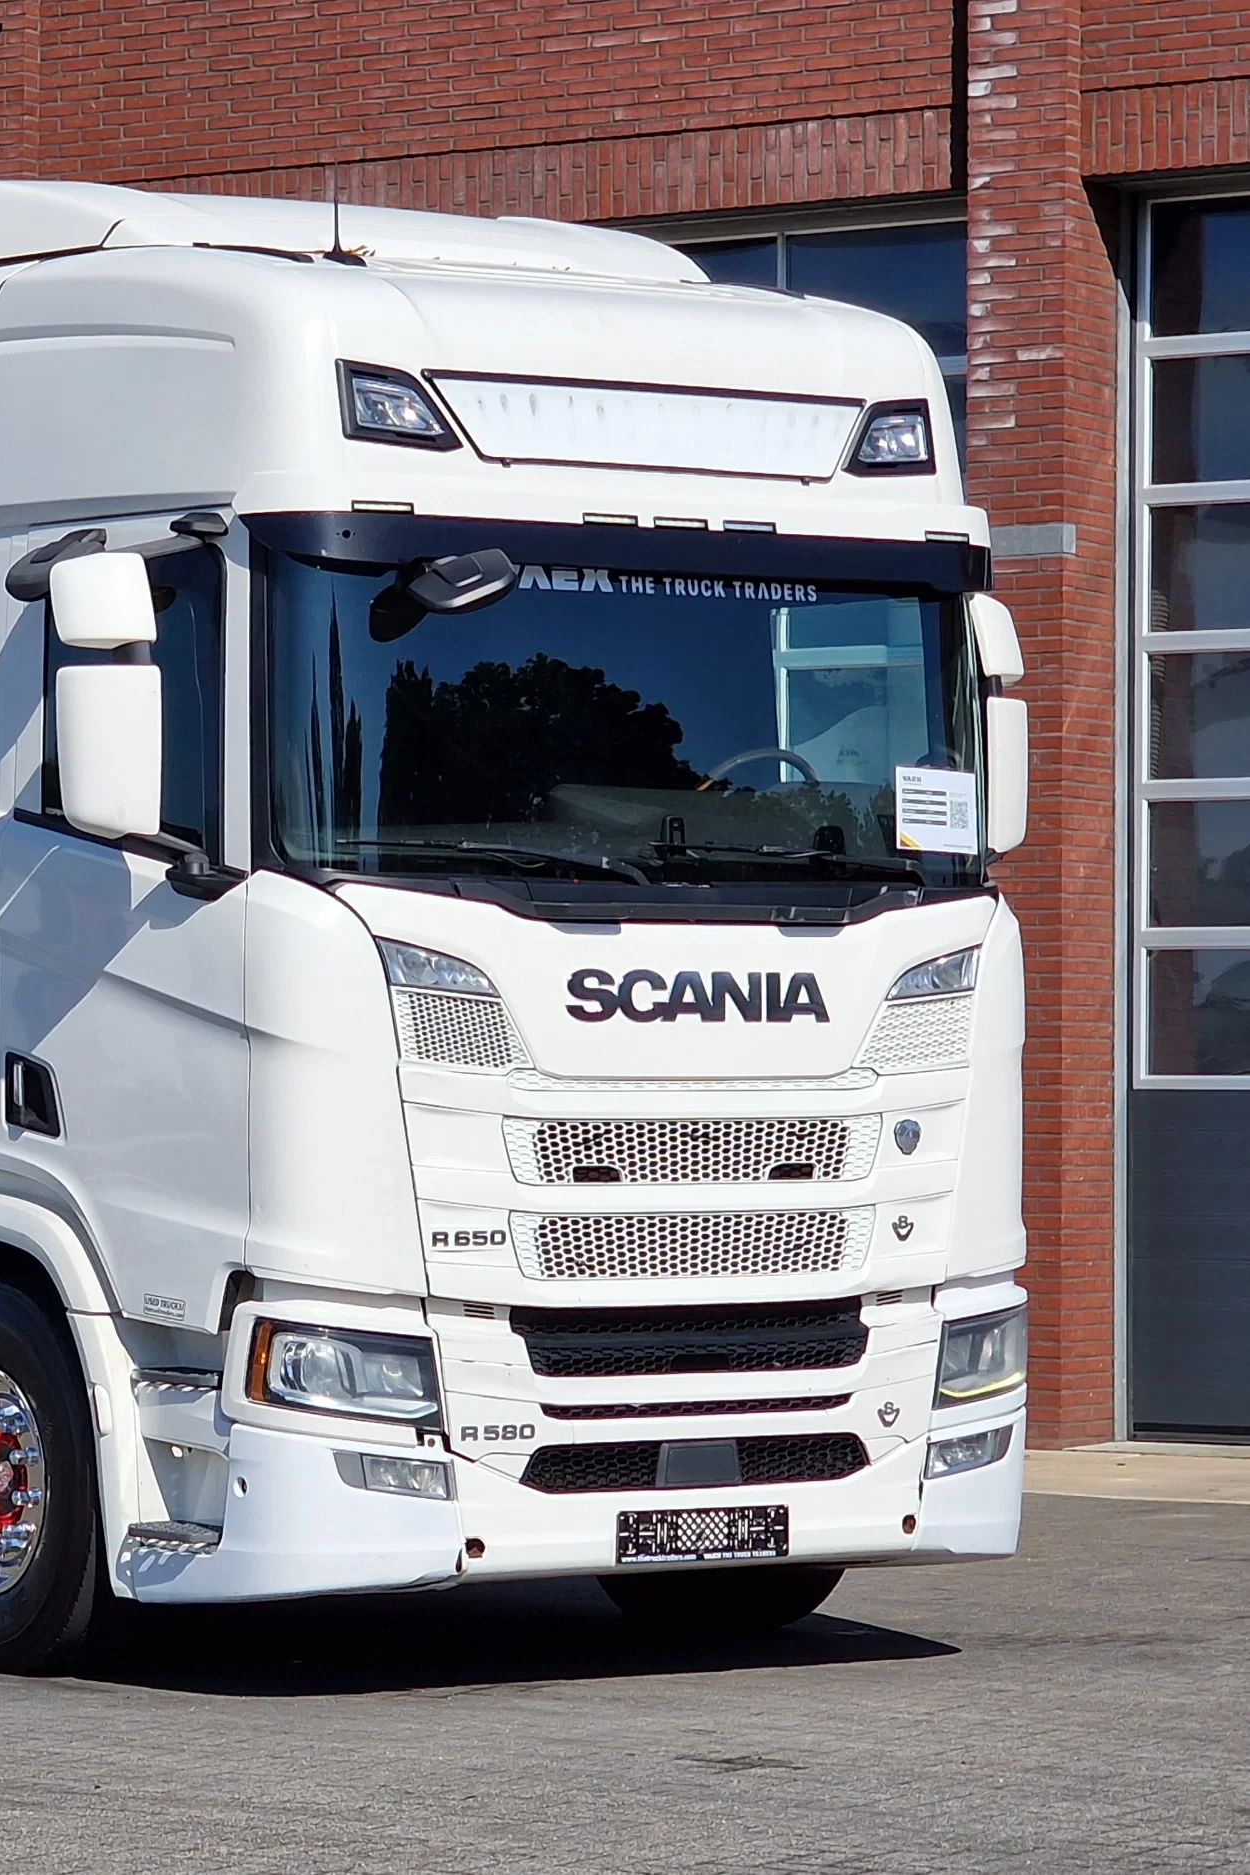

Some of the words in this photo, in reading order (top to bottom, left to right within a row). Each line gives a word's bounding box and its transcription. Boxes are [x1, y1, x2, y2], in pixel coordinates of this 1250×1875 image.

[513, 564, 614, 593] AEX
[618, 575, 655, 595] THE
[662, 577, 726, 598] TRUCK
[732, 581, 817, 602] TRADERS
[565, 968, 830, 1023] SCANIA
[431, 1231, 449, 1247] R
[454, 1229, 506, 1247] 650
[460, 1425, 478, 1441] R
[483, 1423, 535, 1441] 580
